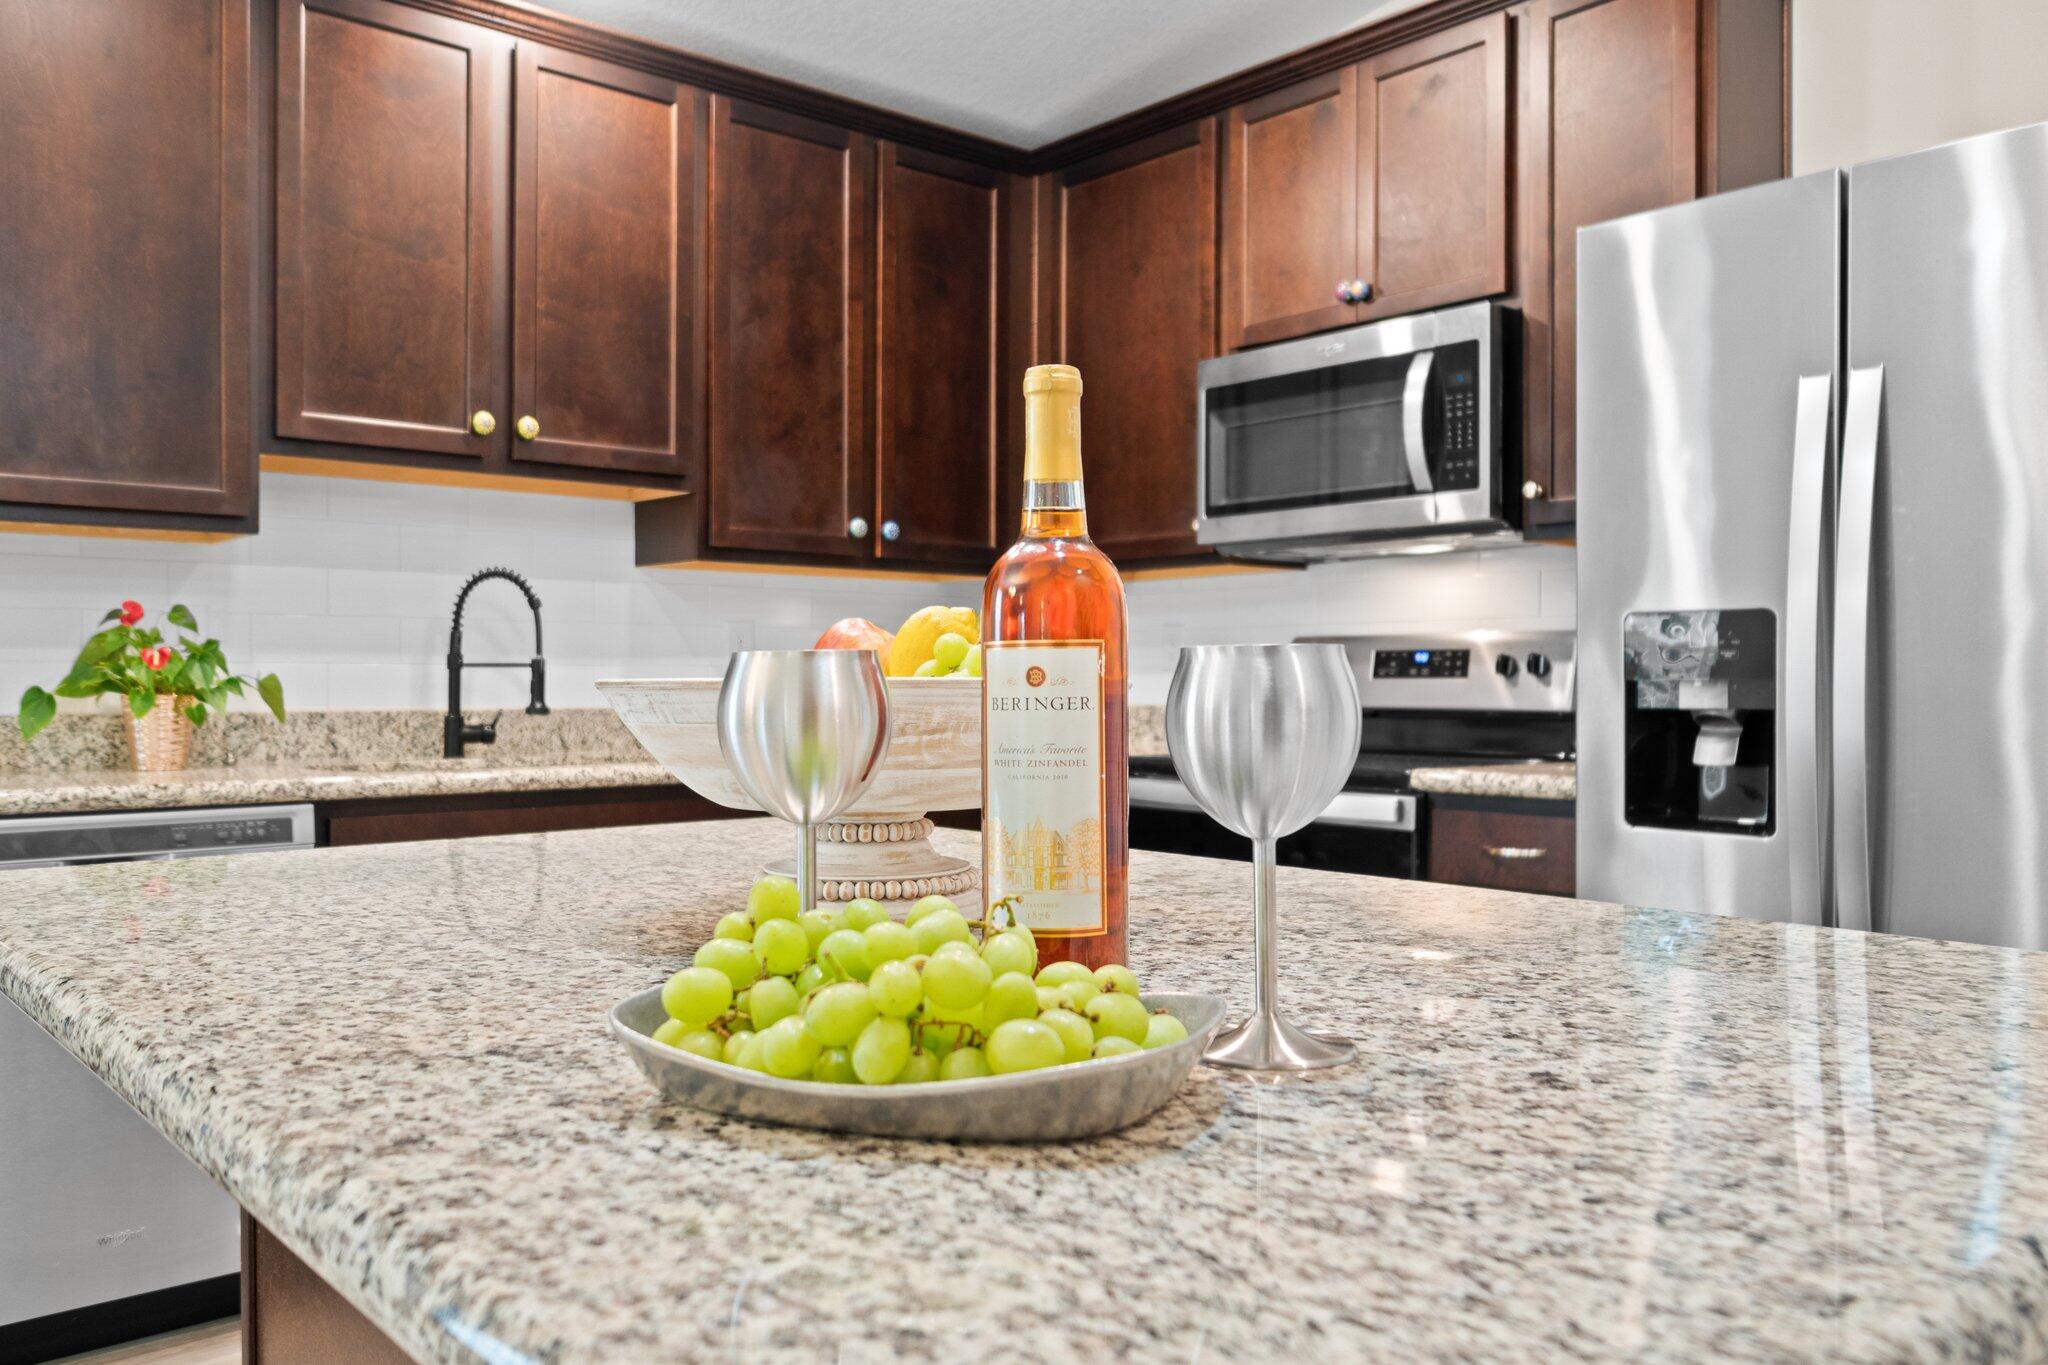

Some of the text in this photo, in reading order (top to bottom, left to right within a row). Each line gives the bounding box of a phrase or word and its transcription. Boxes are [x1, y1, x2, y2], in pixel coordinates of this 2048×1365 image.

[992, 696, 1091, 711] BERINGER
[994, 743, 1087, 754] America's Favorite
[1027, 759, 1089, 767] ZINFANDEL
